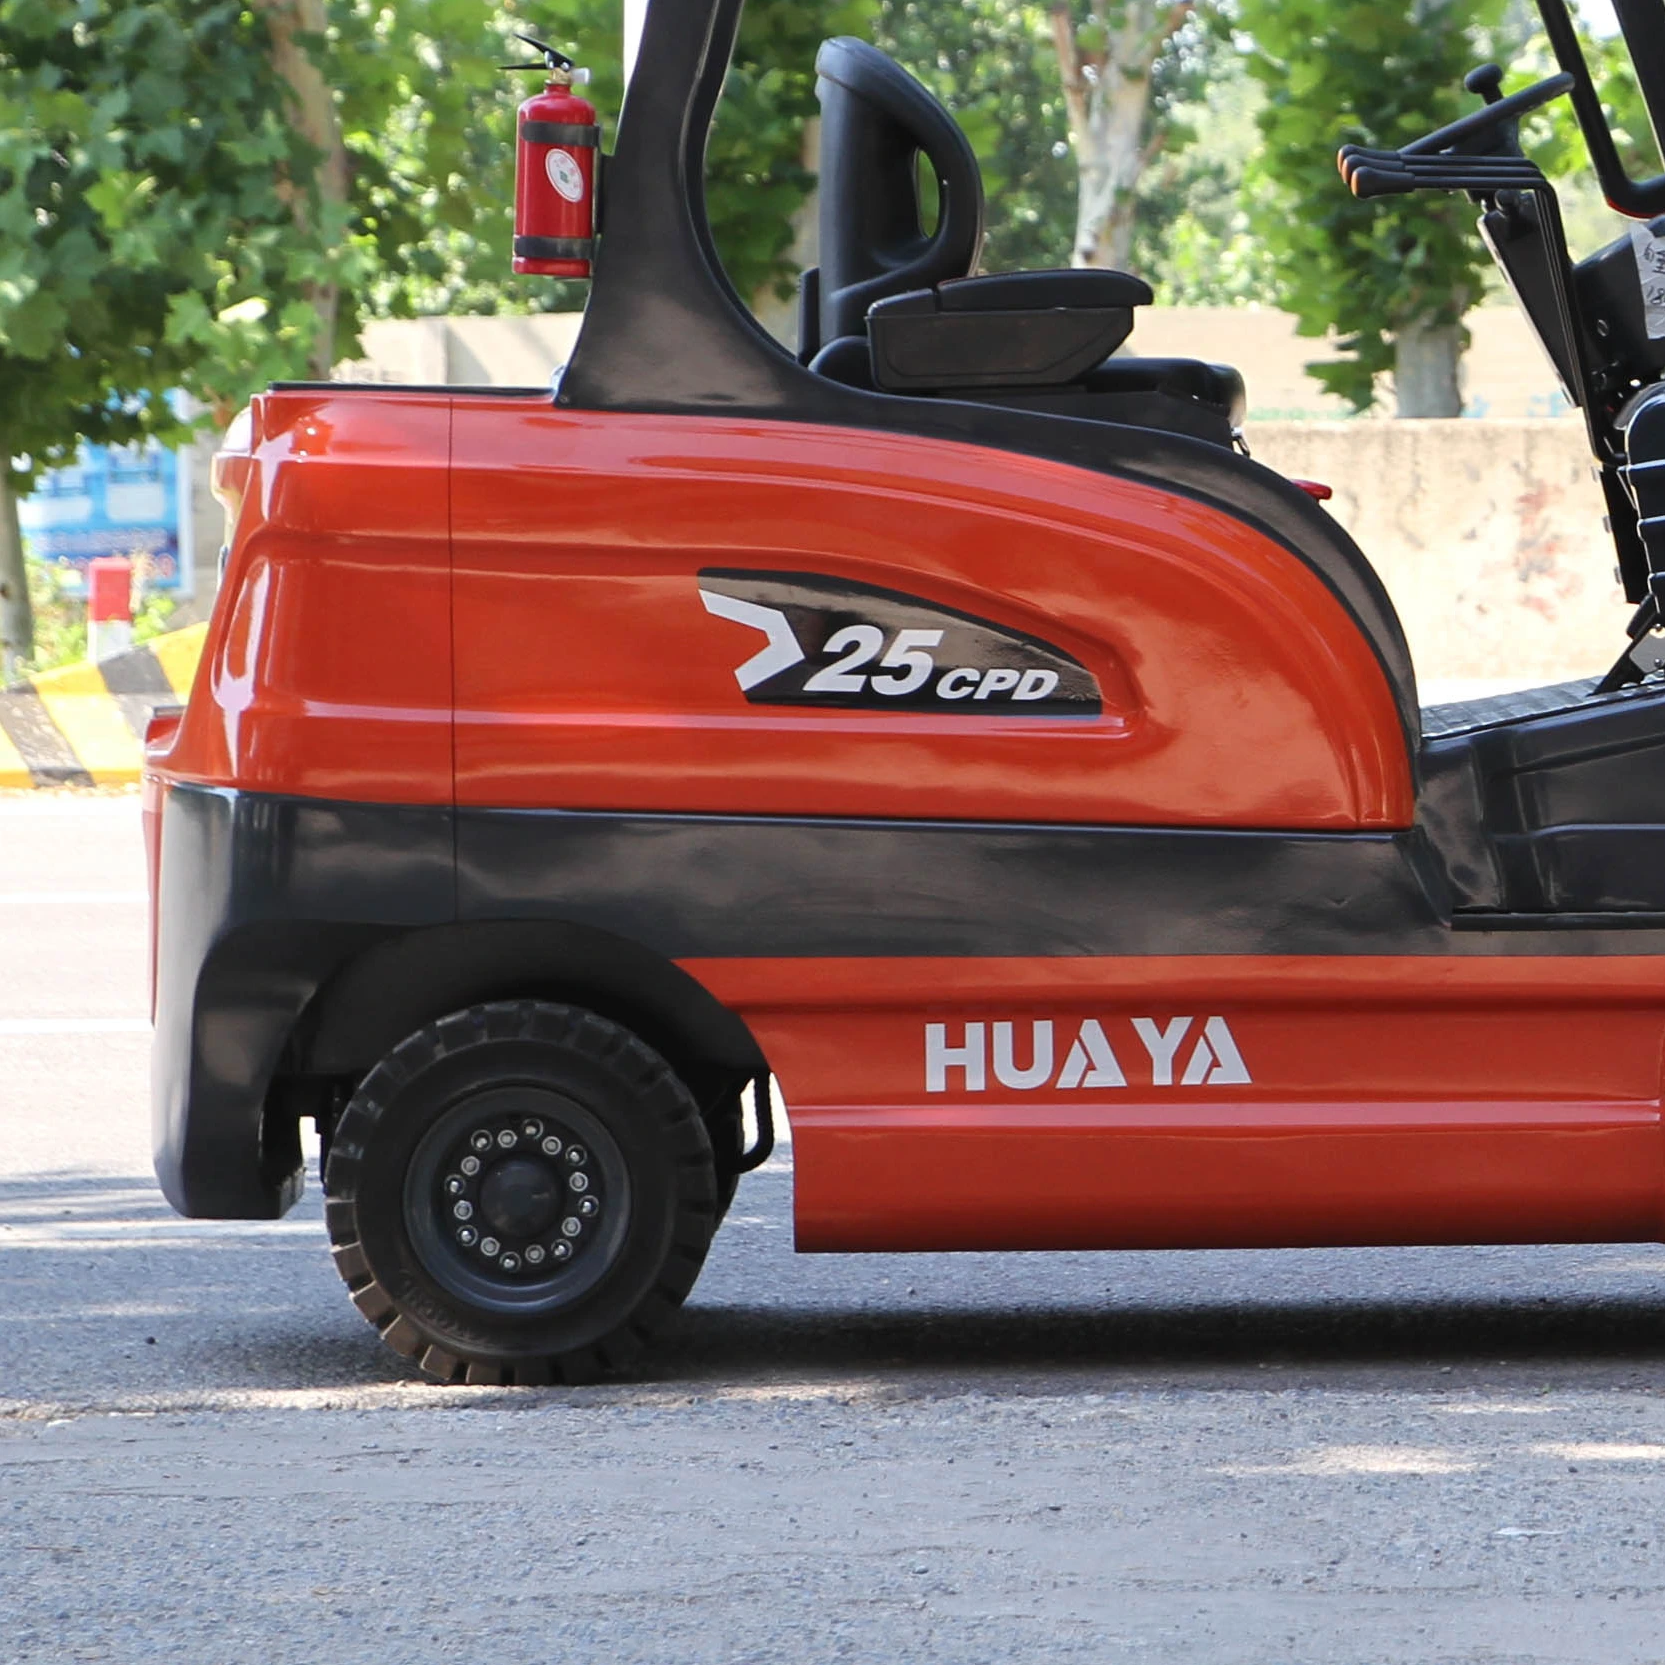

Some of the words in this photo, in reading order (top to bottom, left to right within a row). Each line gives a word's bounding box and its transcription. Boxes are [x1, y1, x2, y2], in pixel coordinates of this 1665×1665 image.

[803, 624, 944, 696] 25
[935, 667, 1059, 701] CPD
[924, 1015, 1253, 1093] HUAYA
